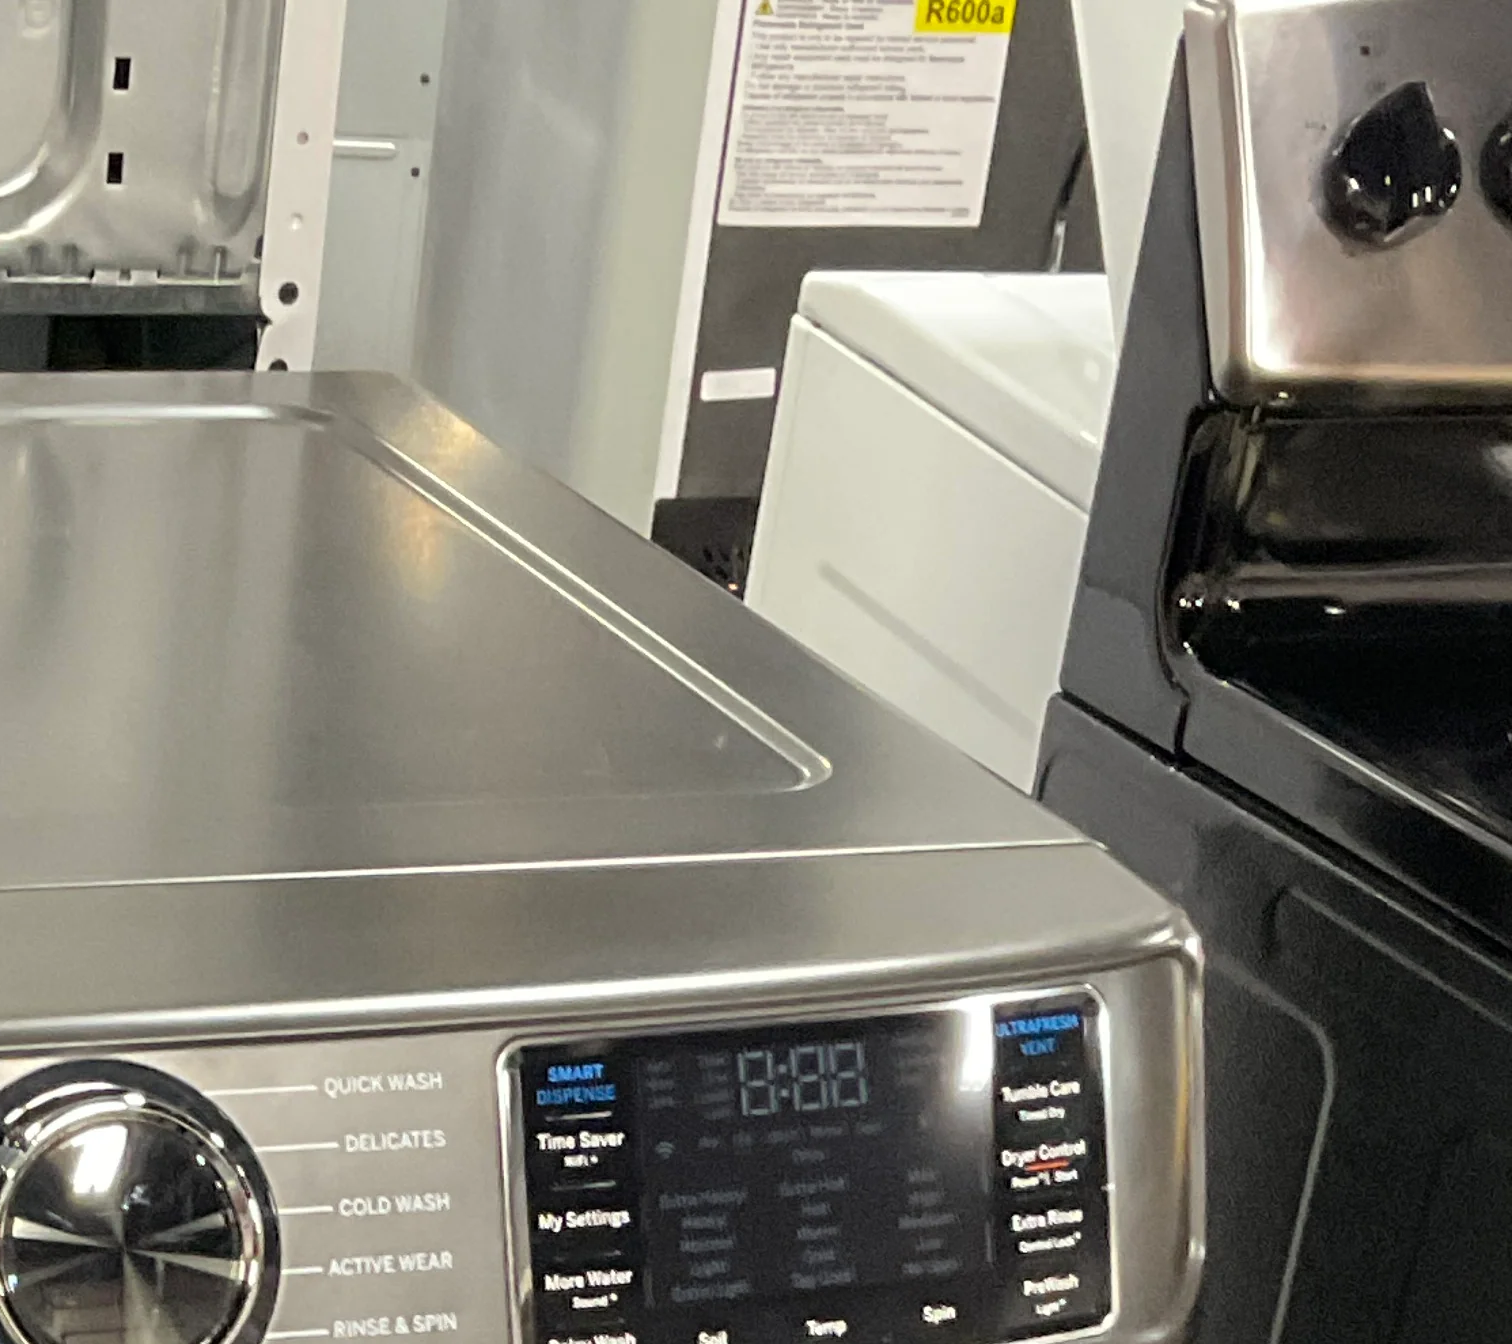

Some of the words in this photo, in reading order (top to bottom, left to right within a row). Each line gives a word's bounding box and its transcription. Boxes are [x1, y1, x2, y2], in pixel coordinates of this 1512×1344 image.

[925, 1, 1005, 25] R600a
[324, 1075, 384, 1099] QUICK
[387, 1071, 443, 1092] WASH
[546, 1063, 605, 1083] SMART
[536, 1084, 617, 1106] DISPENSE
[344, 1129, 447, 1153] DELICATES
[536, 1132, 576, 1151] Time
[578, 1130, 626, 1149] Saver
[339, 1195, 392, 1218] COLD
[394, 1192, 451, 1213] WASH
[538, 1212, 563, 1233] My
[565, 1209, 631, 1229] Settings
[328, 1254, 396, 1278] ACTIVE
[398, 1250, 454, 1272] WEAR
[586, 1269, 634, 1287] Water
[332, 1316, 392, 1339] RINSE
[394, 1316, 410, 1335] &
[412, 1312, 458, 1334] SPIN
[921, 1304, 958, 1325] Spin
[805, 1319, 848, 1339] Temp
